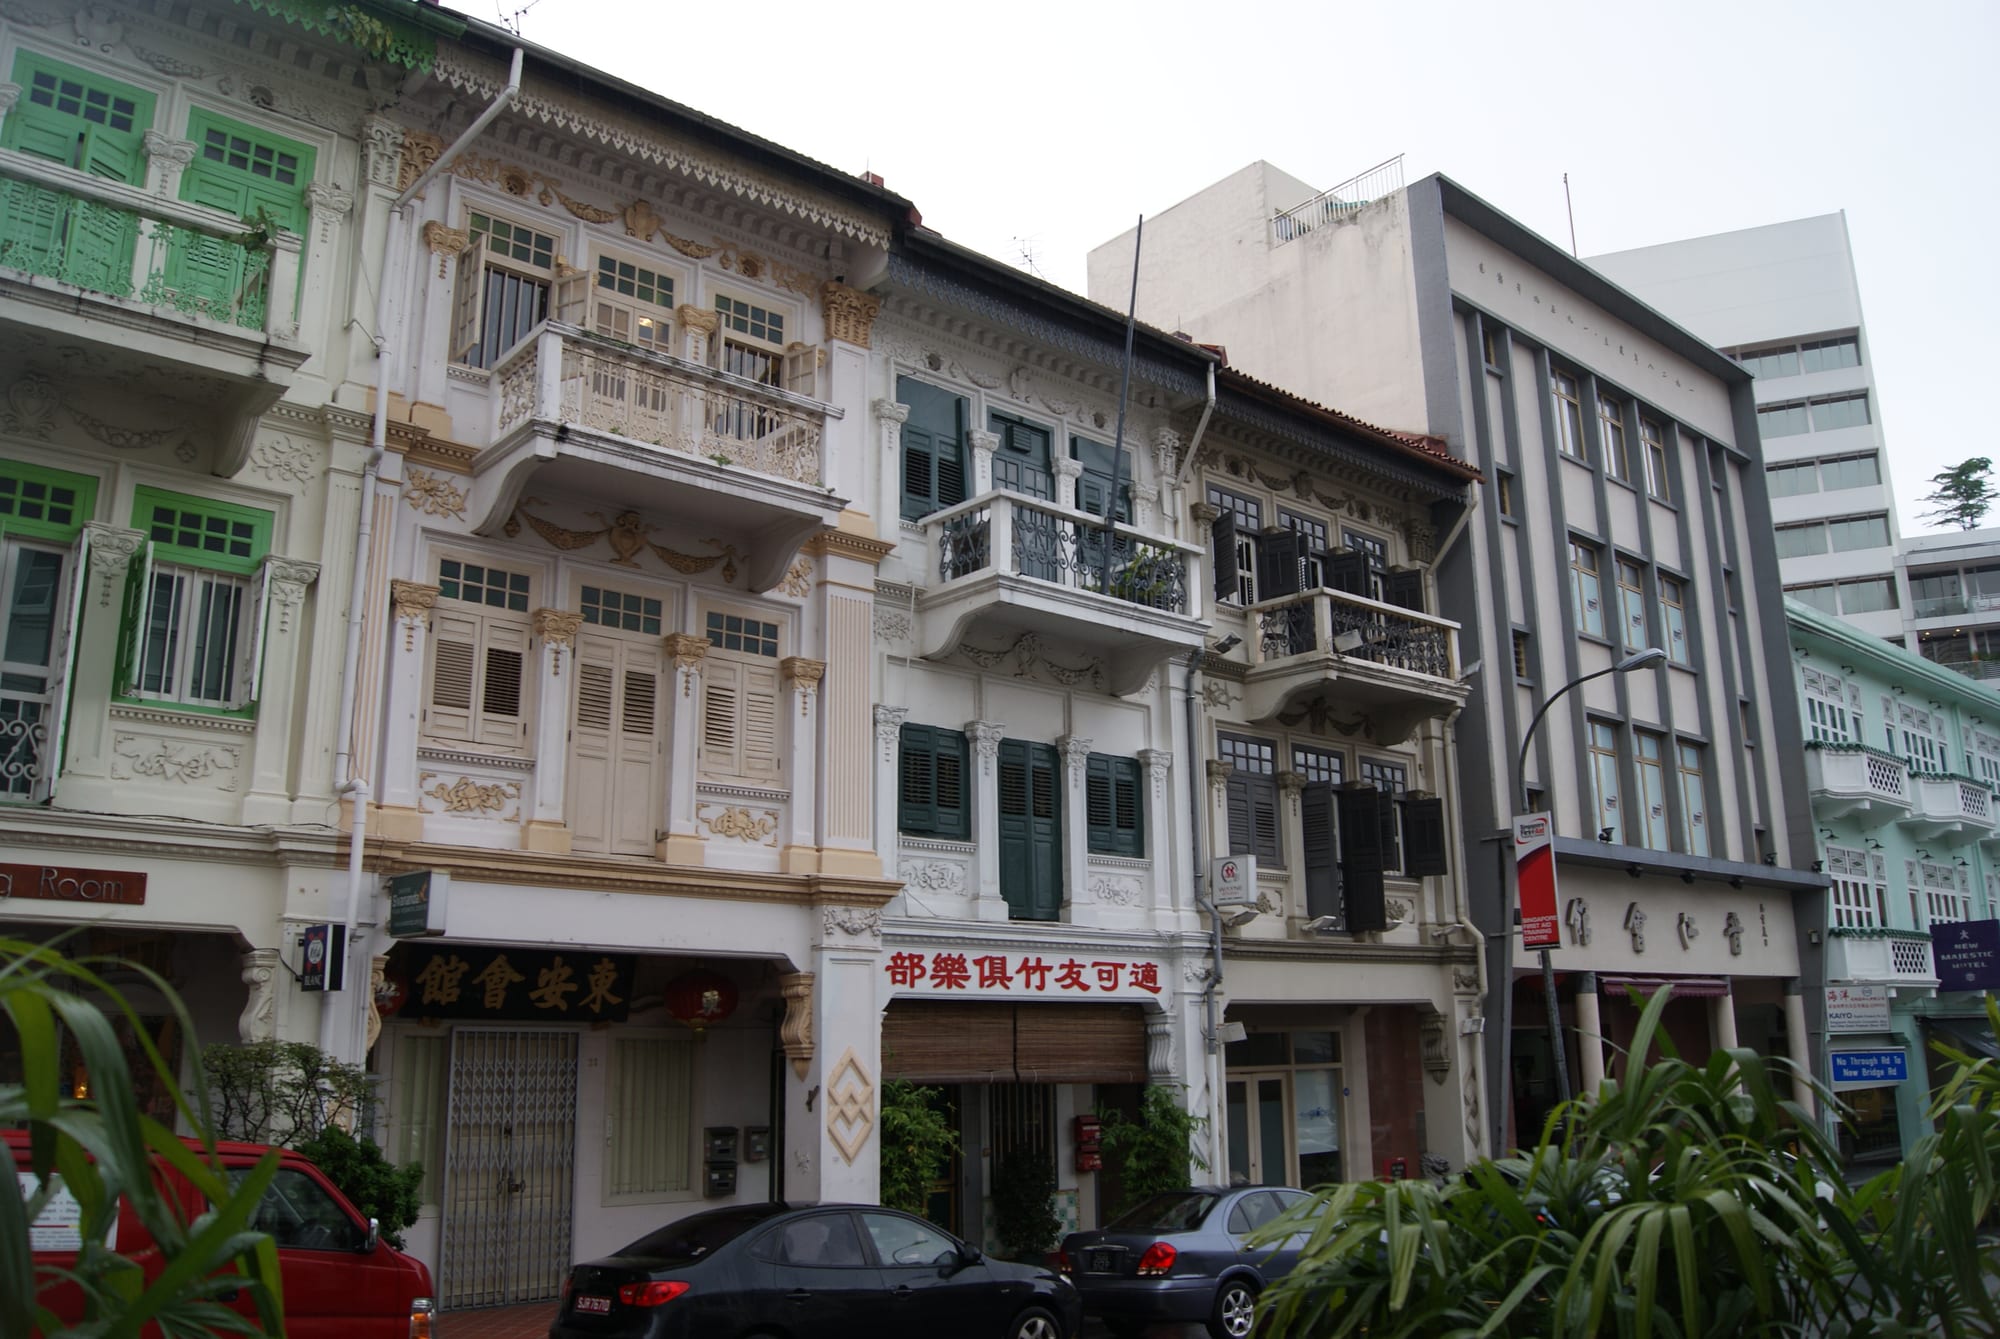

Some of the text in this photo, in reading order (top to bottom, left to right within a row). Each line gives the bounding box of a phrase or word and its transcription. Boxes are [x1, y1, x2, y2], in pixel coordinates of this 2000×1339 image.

[40, 867, 124, 900] Room
[1941, 951, 1993, 960] MAJESTIC
[1836, 1056, 1901, 1067] No Through Rd To
[1843, 1067, 1897, 1078] New Bridge Rd
